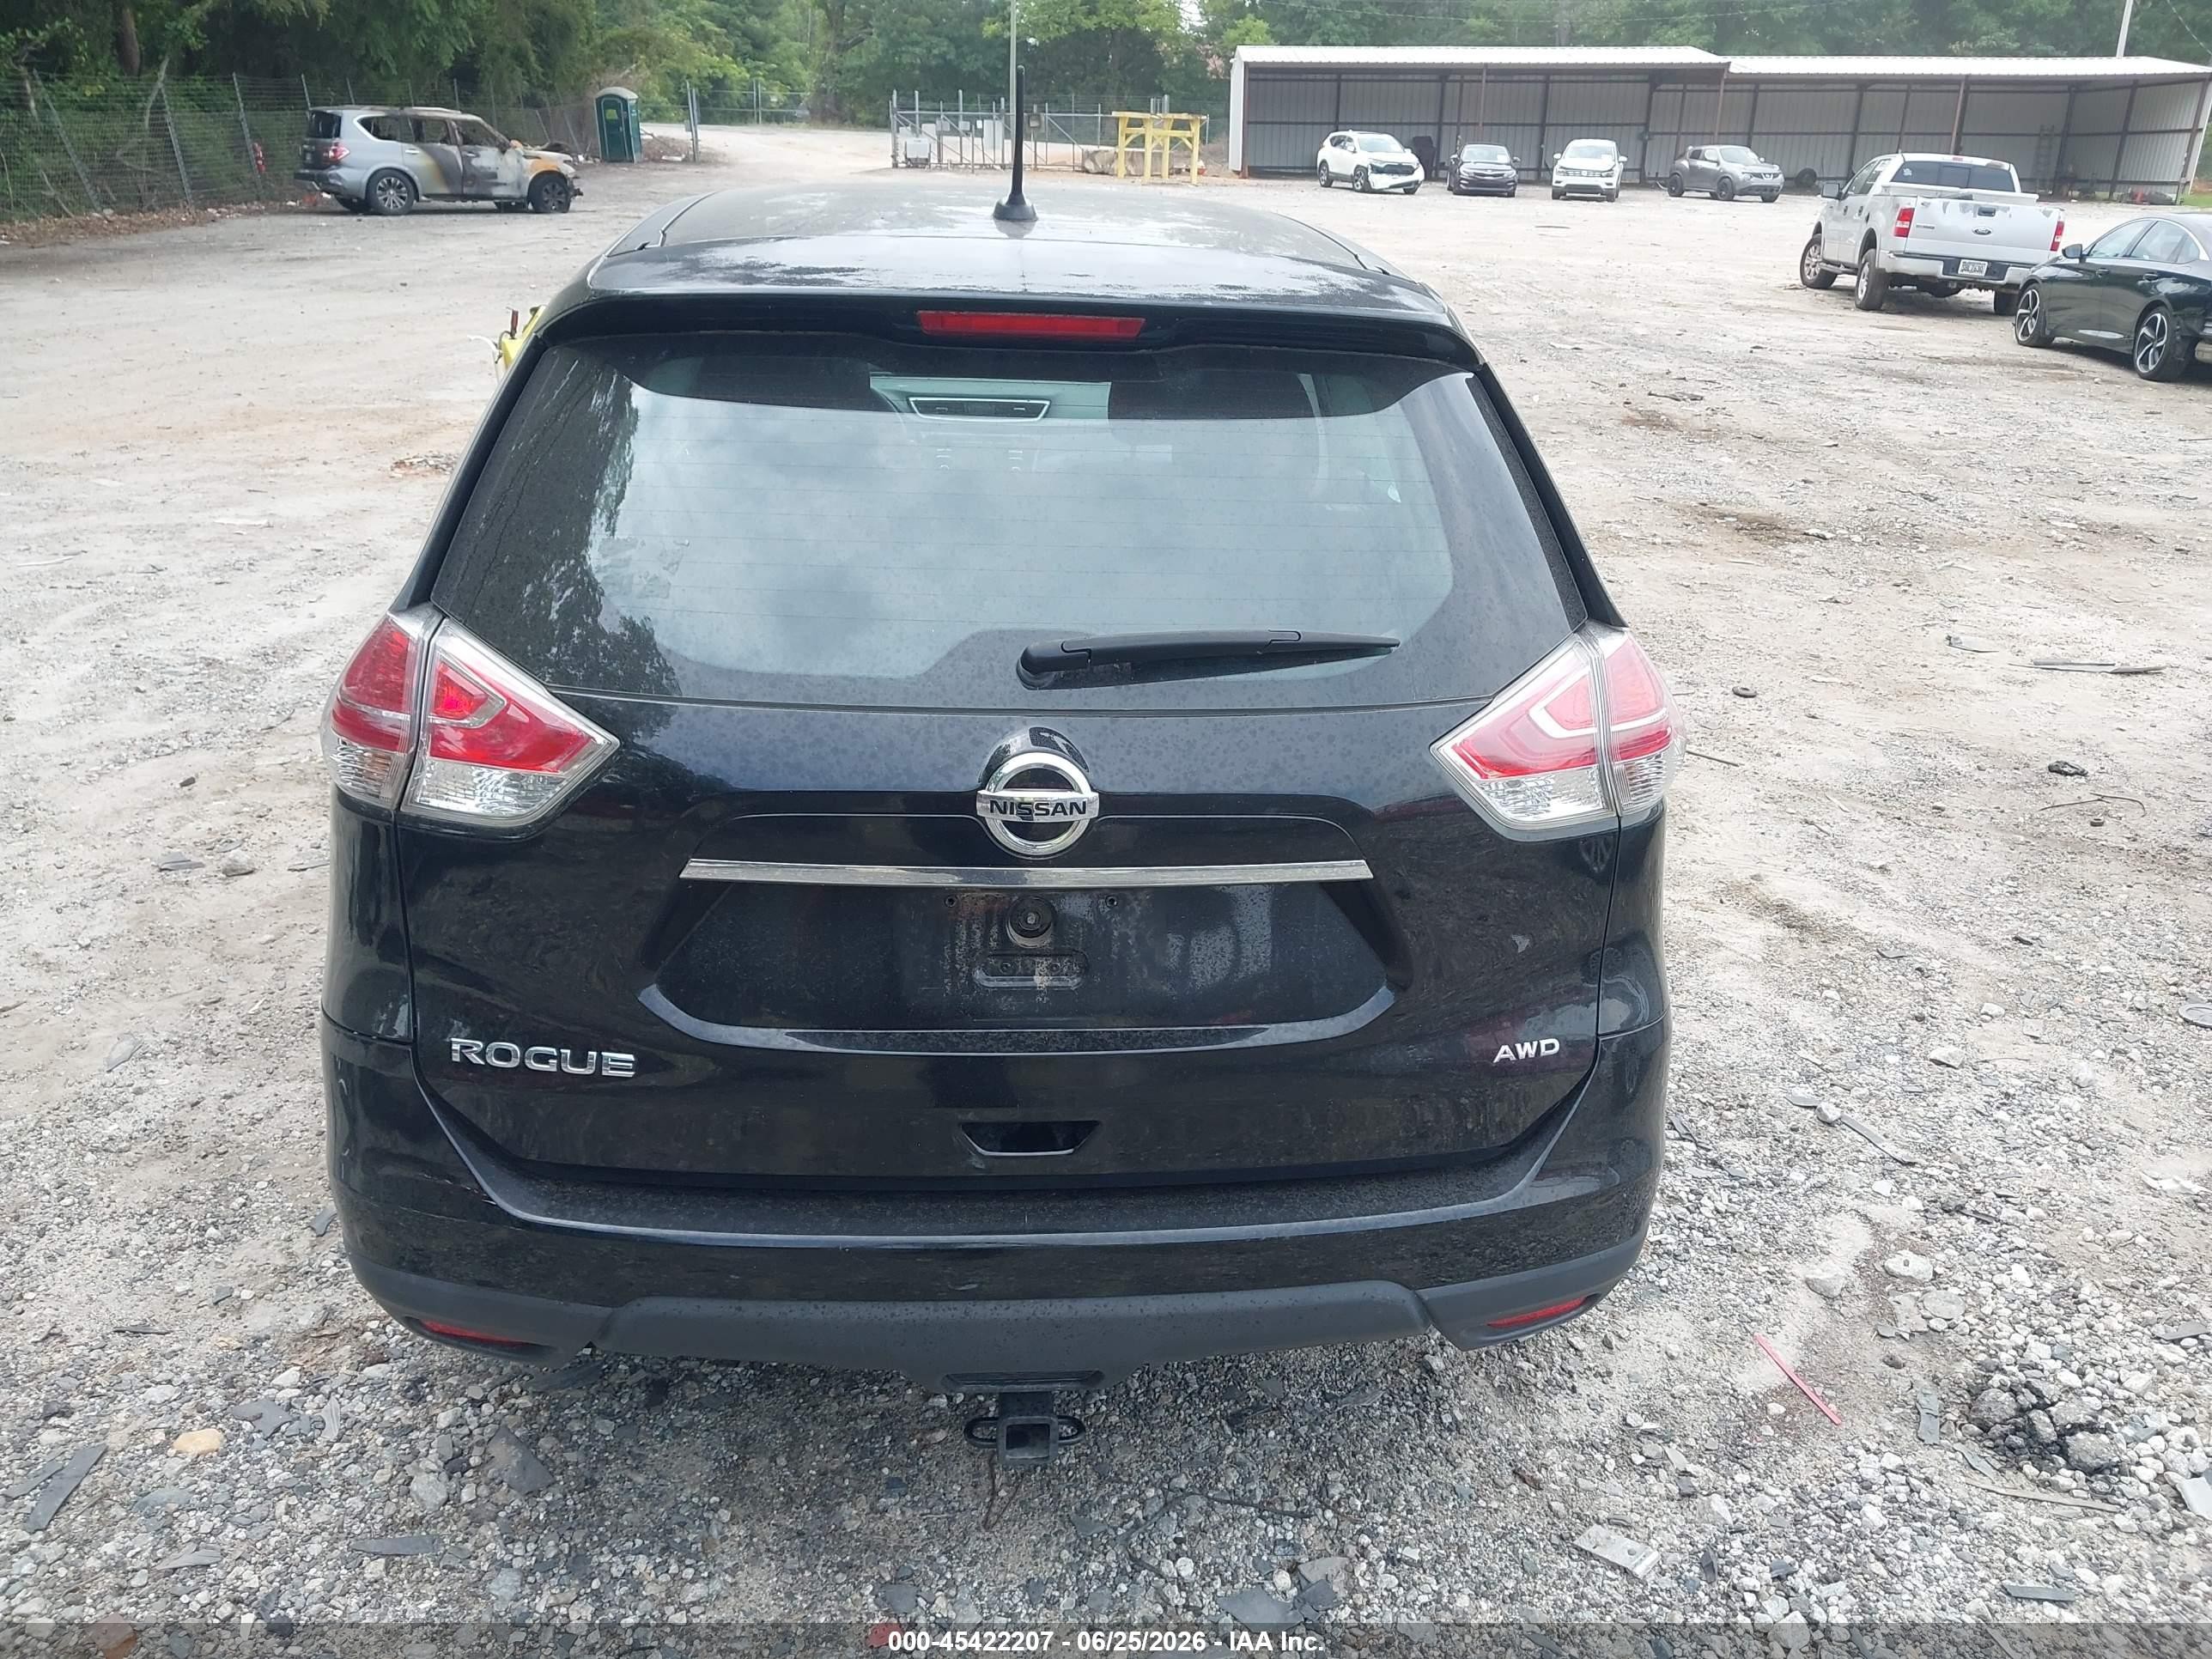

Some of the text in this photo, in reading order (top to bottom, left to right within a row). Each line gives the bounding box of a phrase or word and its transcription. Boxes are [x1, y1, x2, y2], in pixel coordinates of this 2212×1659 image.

[989, 799, 1087, 817] NISSAN
[450, 1037, 636, 1078] ROGUE
[1492, 1037, 1560, 1064] AWD
